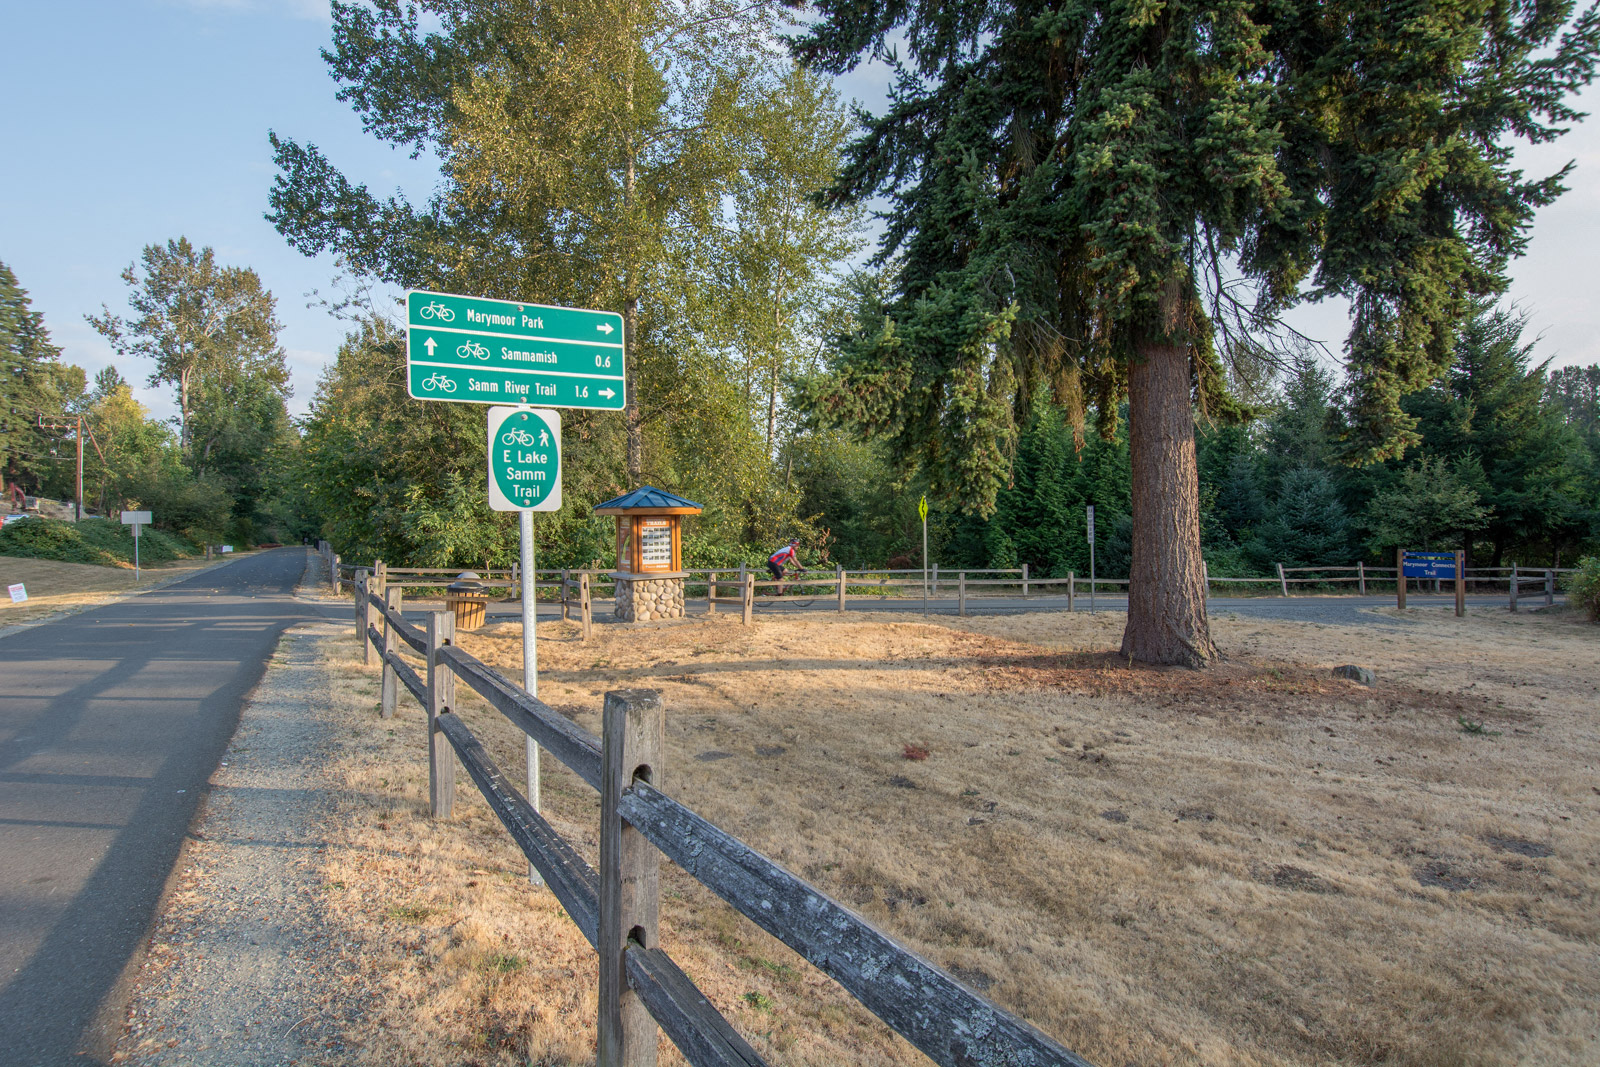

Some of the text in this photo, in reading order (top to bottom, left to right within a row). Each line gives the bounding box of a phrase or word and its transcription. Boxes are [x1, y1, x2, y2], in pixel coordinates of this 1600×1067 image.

[467, 308, 544, 329] Marymoor Park
[501, 347, 611, 368] Sammamish 0.6
[468, 377, 589, 398] Samm River Trail 1.6
[503, 449, 548, 464] E Lake
[506, 466, 546, 481] Samm
[513, 484, 540, 498] Trail
